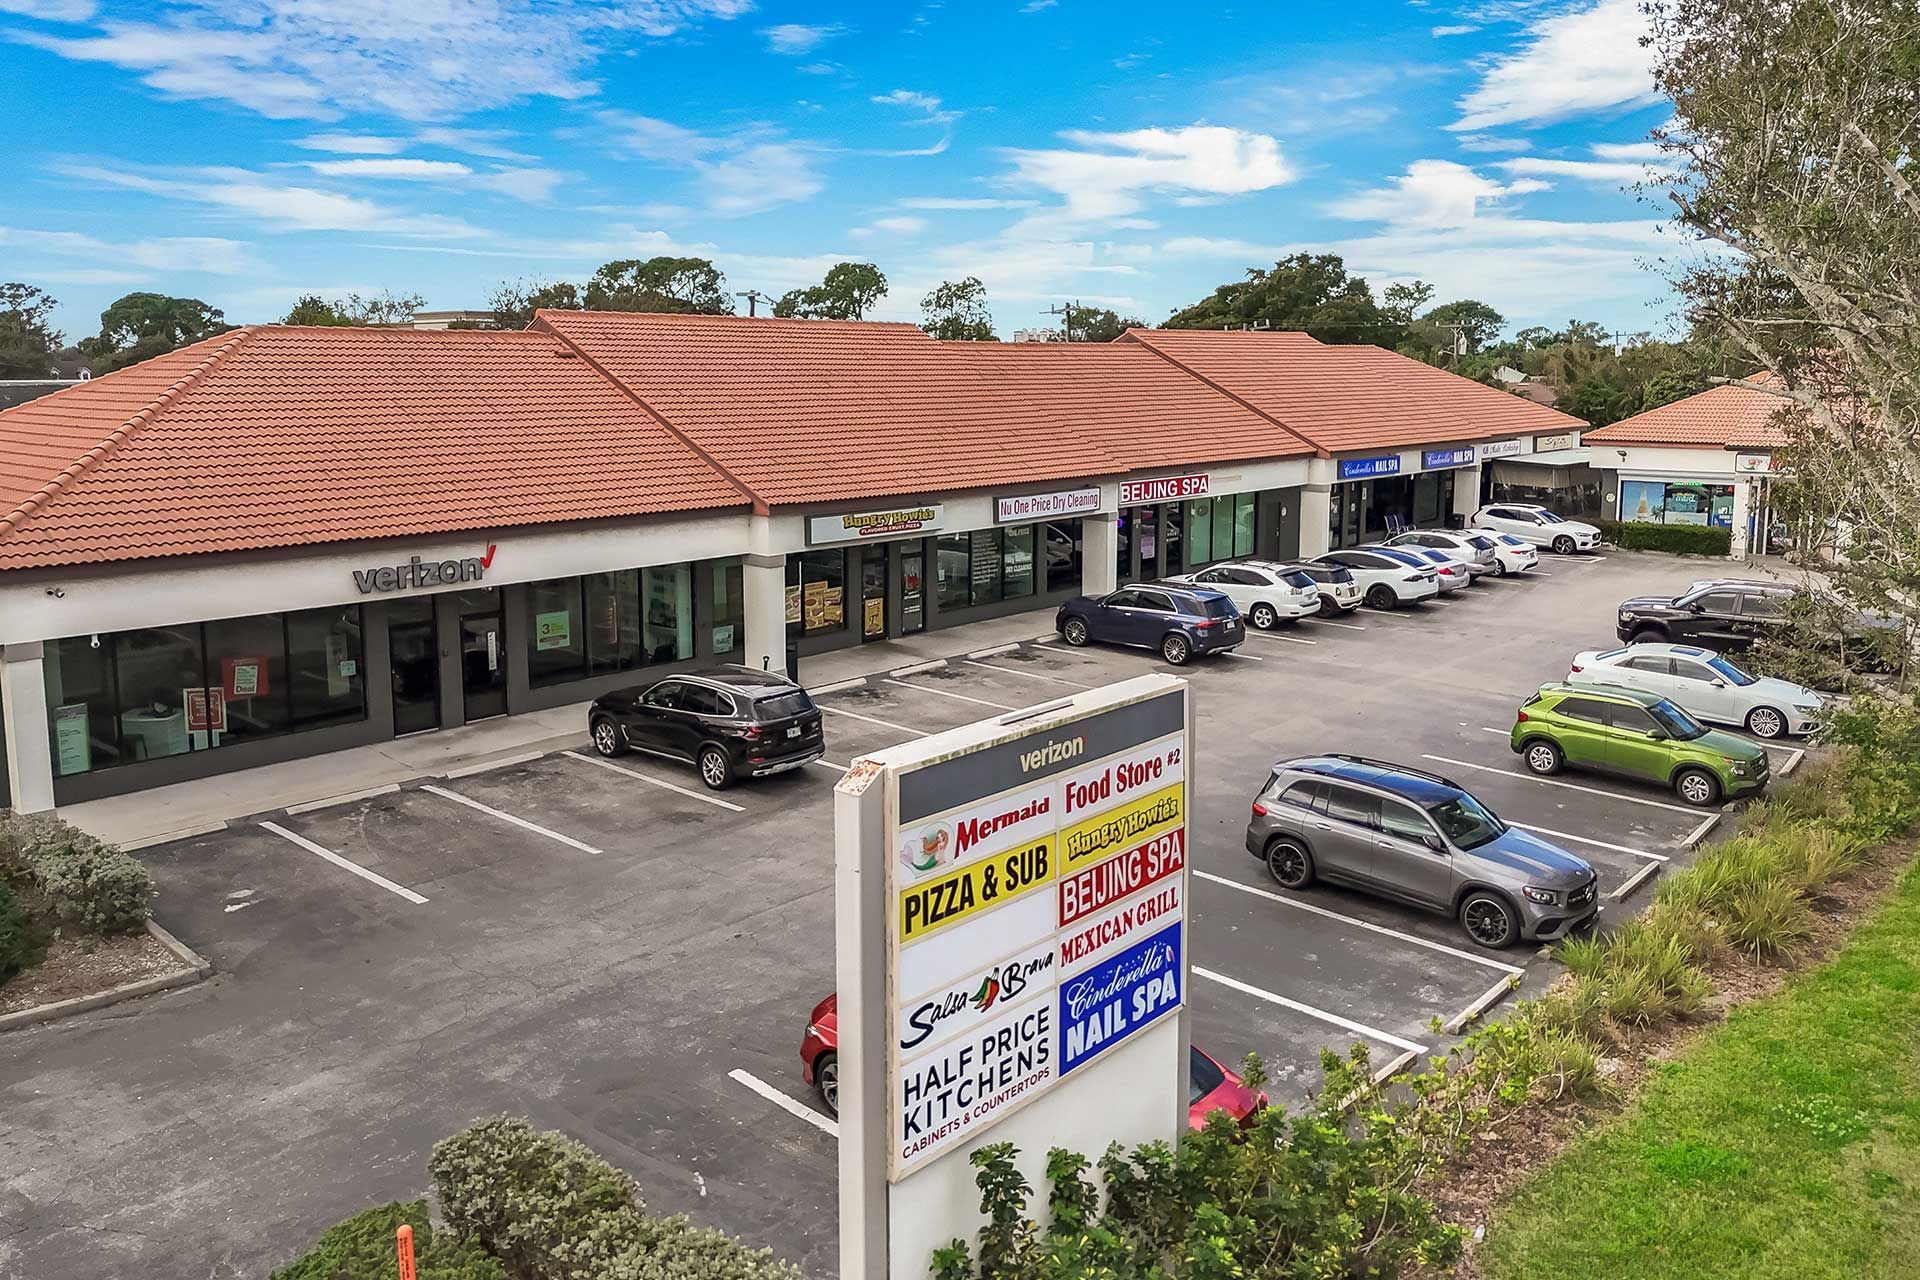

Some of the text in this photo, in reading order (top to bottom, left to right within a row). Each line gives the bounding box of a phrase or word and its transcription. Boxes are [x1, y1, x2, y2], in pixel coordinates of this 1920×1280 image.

[1121, 477, 1209, 502] BEIJING SPA
[1388, 458, 1398, 471] SPA
[843, 508, 935, 529] Hungry Howie's
[861, 526, 888, 535] FLAVORED
[1000, 492, 1098, 516] Nu One Price Dry Cleaning
[353, 556, 483, 594] verizon
[542, 623, 550, 635] 3
[1019, 735, 1083, 773] verizon
[954, 748, 1180, 860] Mermaid Food Store #2
[1067, 797, 1179, 861] Hungry Howie's
[905, 844, 1048, 935] PIZZA & SUB
[1062, 832, 1183, 922] BEIJING SPA
[1060, 887, 1179, 968] MEXICAN GRILL
[900, 951, 1054, 1050] Salsa Brava
[1066, 946, 1164, 1021] Cinderella
[1066, 969, 1178, 1062] NAIL SPA
[903, 1037, 1050, 1141] KITCHENS
[904, 1006, 1050, 1107] HALF PRICE
[902, 1067, 1050, 1160] CABINETS & COUNTERTOPS
